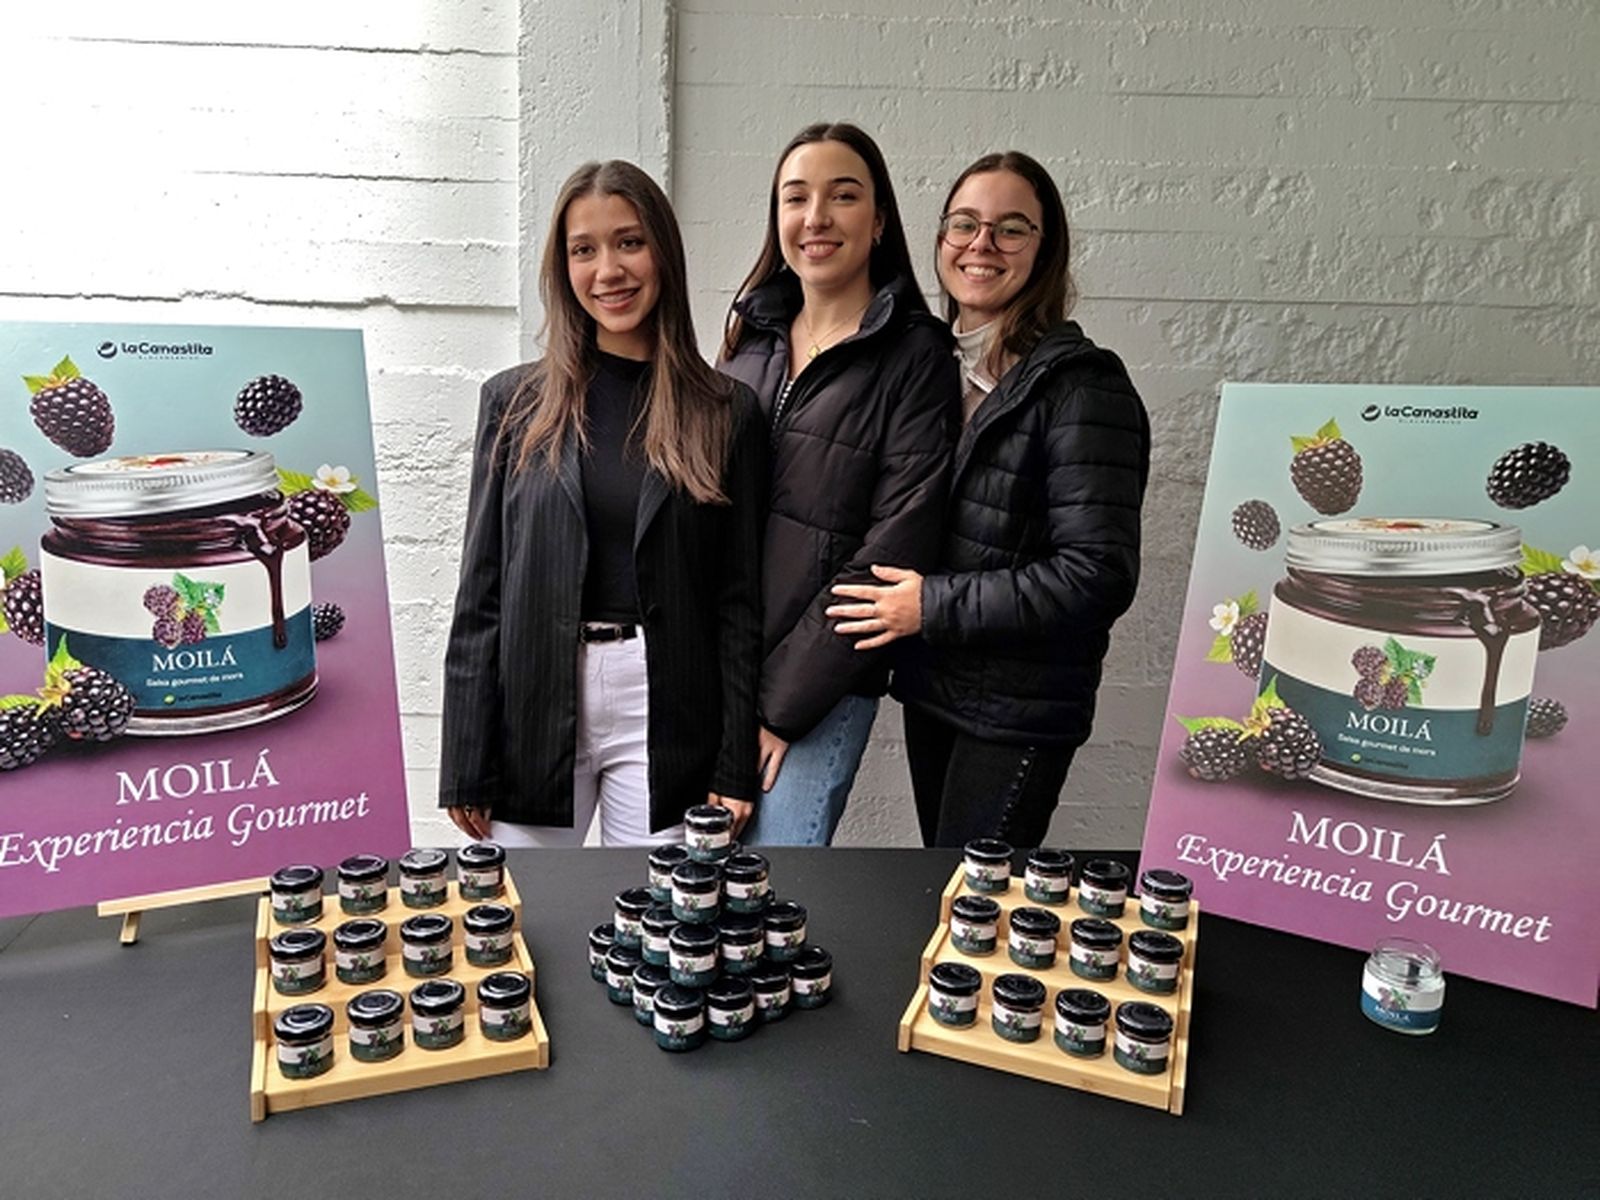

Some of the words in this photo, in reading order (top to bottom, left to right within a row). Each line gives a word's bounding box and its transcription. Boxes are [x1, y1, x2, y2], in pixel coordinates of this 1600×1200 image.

[152, 644, 237, 672] MOILÁ
[1346, 711, 1432, 741] MOILÁ
[115, 748, 280, 805] MOILÁ
[0, 809, 215, 873] Experiencia
[227, 792, 370, 847] Gourmet
[1286, 811, 1452, 876] MOILÁ
[1176, 833, 1373, 903] Experiencia
[1385, 881, 1553, 943] Gourmet
